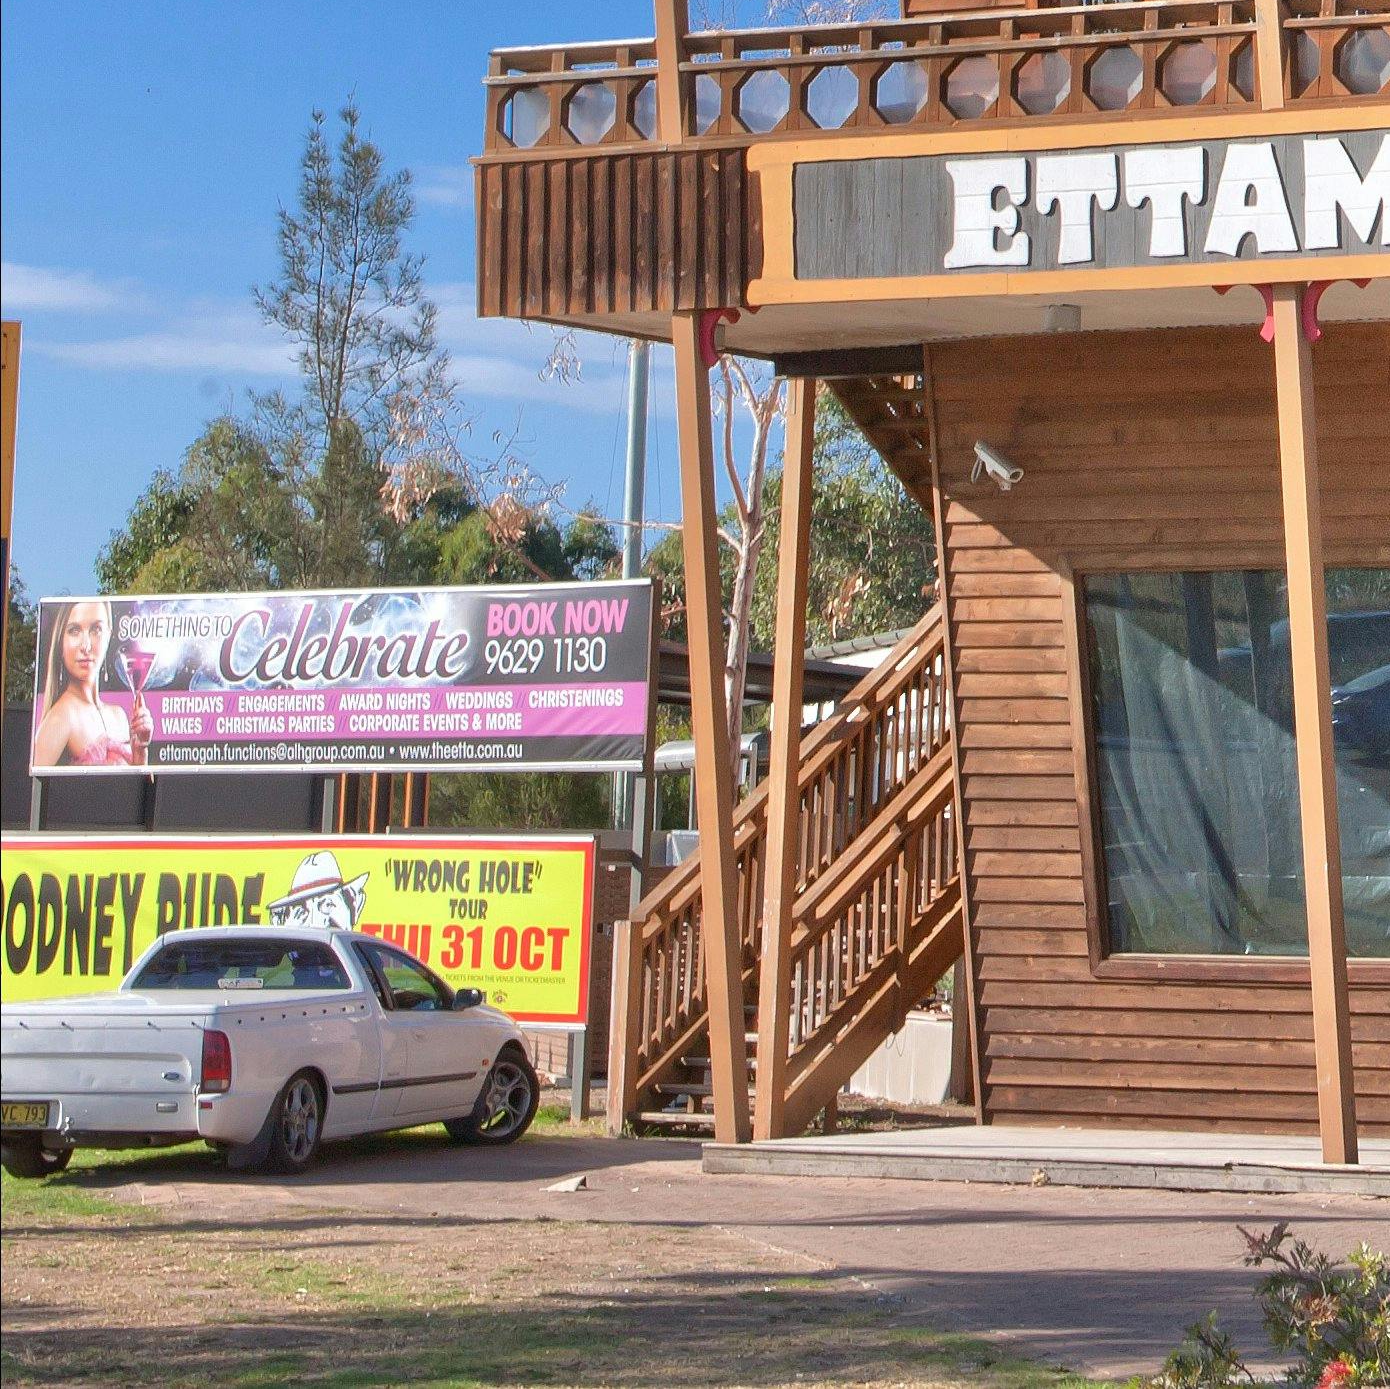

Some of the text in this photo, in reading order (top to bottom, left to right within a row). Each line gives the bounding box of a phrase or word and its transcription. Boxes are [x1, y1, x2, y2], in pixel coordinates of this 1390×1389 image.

[119, 614, 233, 640] SOMETHING TO
[486, 598, 629, 637] BOOK NOW
[219, 600, 470, 683] Celebrate
[485, 636, 606, 675] 9629 1130
[161, 688, 624, 714] BIRTHDAYS ENGAGEMENTS AWARD NIGHTS WEDDINGS CHRISTENINGS
[161, 712, 522, 735] WAKES CHRISTMAS PARTIES CORPORATE EVENTS & MORE
[159, 741, 523, 765] ettamogah.functions@alhgroup.com.au www.theetta.com.au
[385, 858, 543, 894] "WRONG HOLE"
[1, 872, 146, 976] ODNEY
[449, 898, 488, 920] TOUR
[441, 925, 484, 970] 31
[493, 925, 570, 971] OCT
